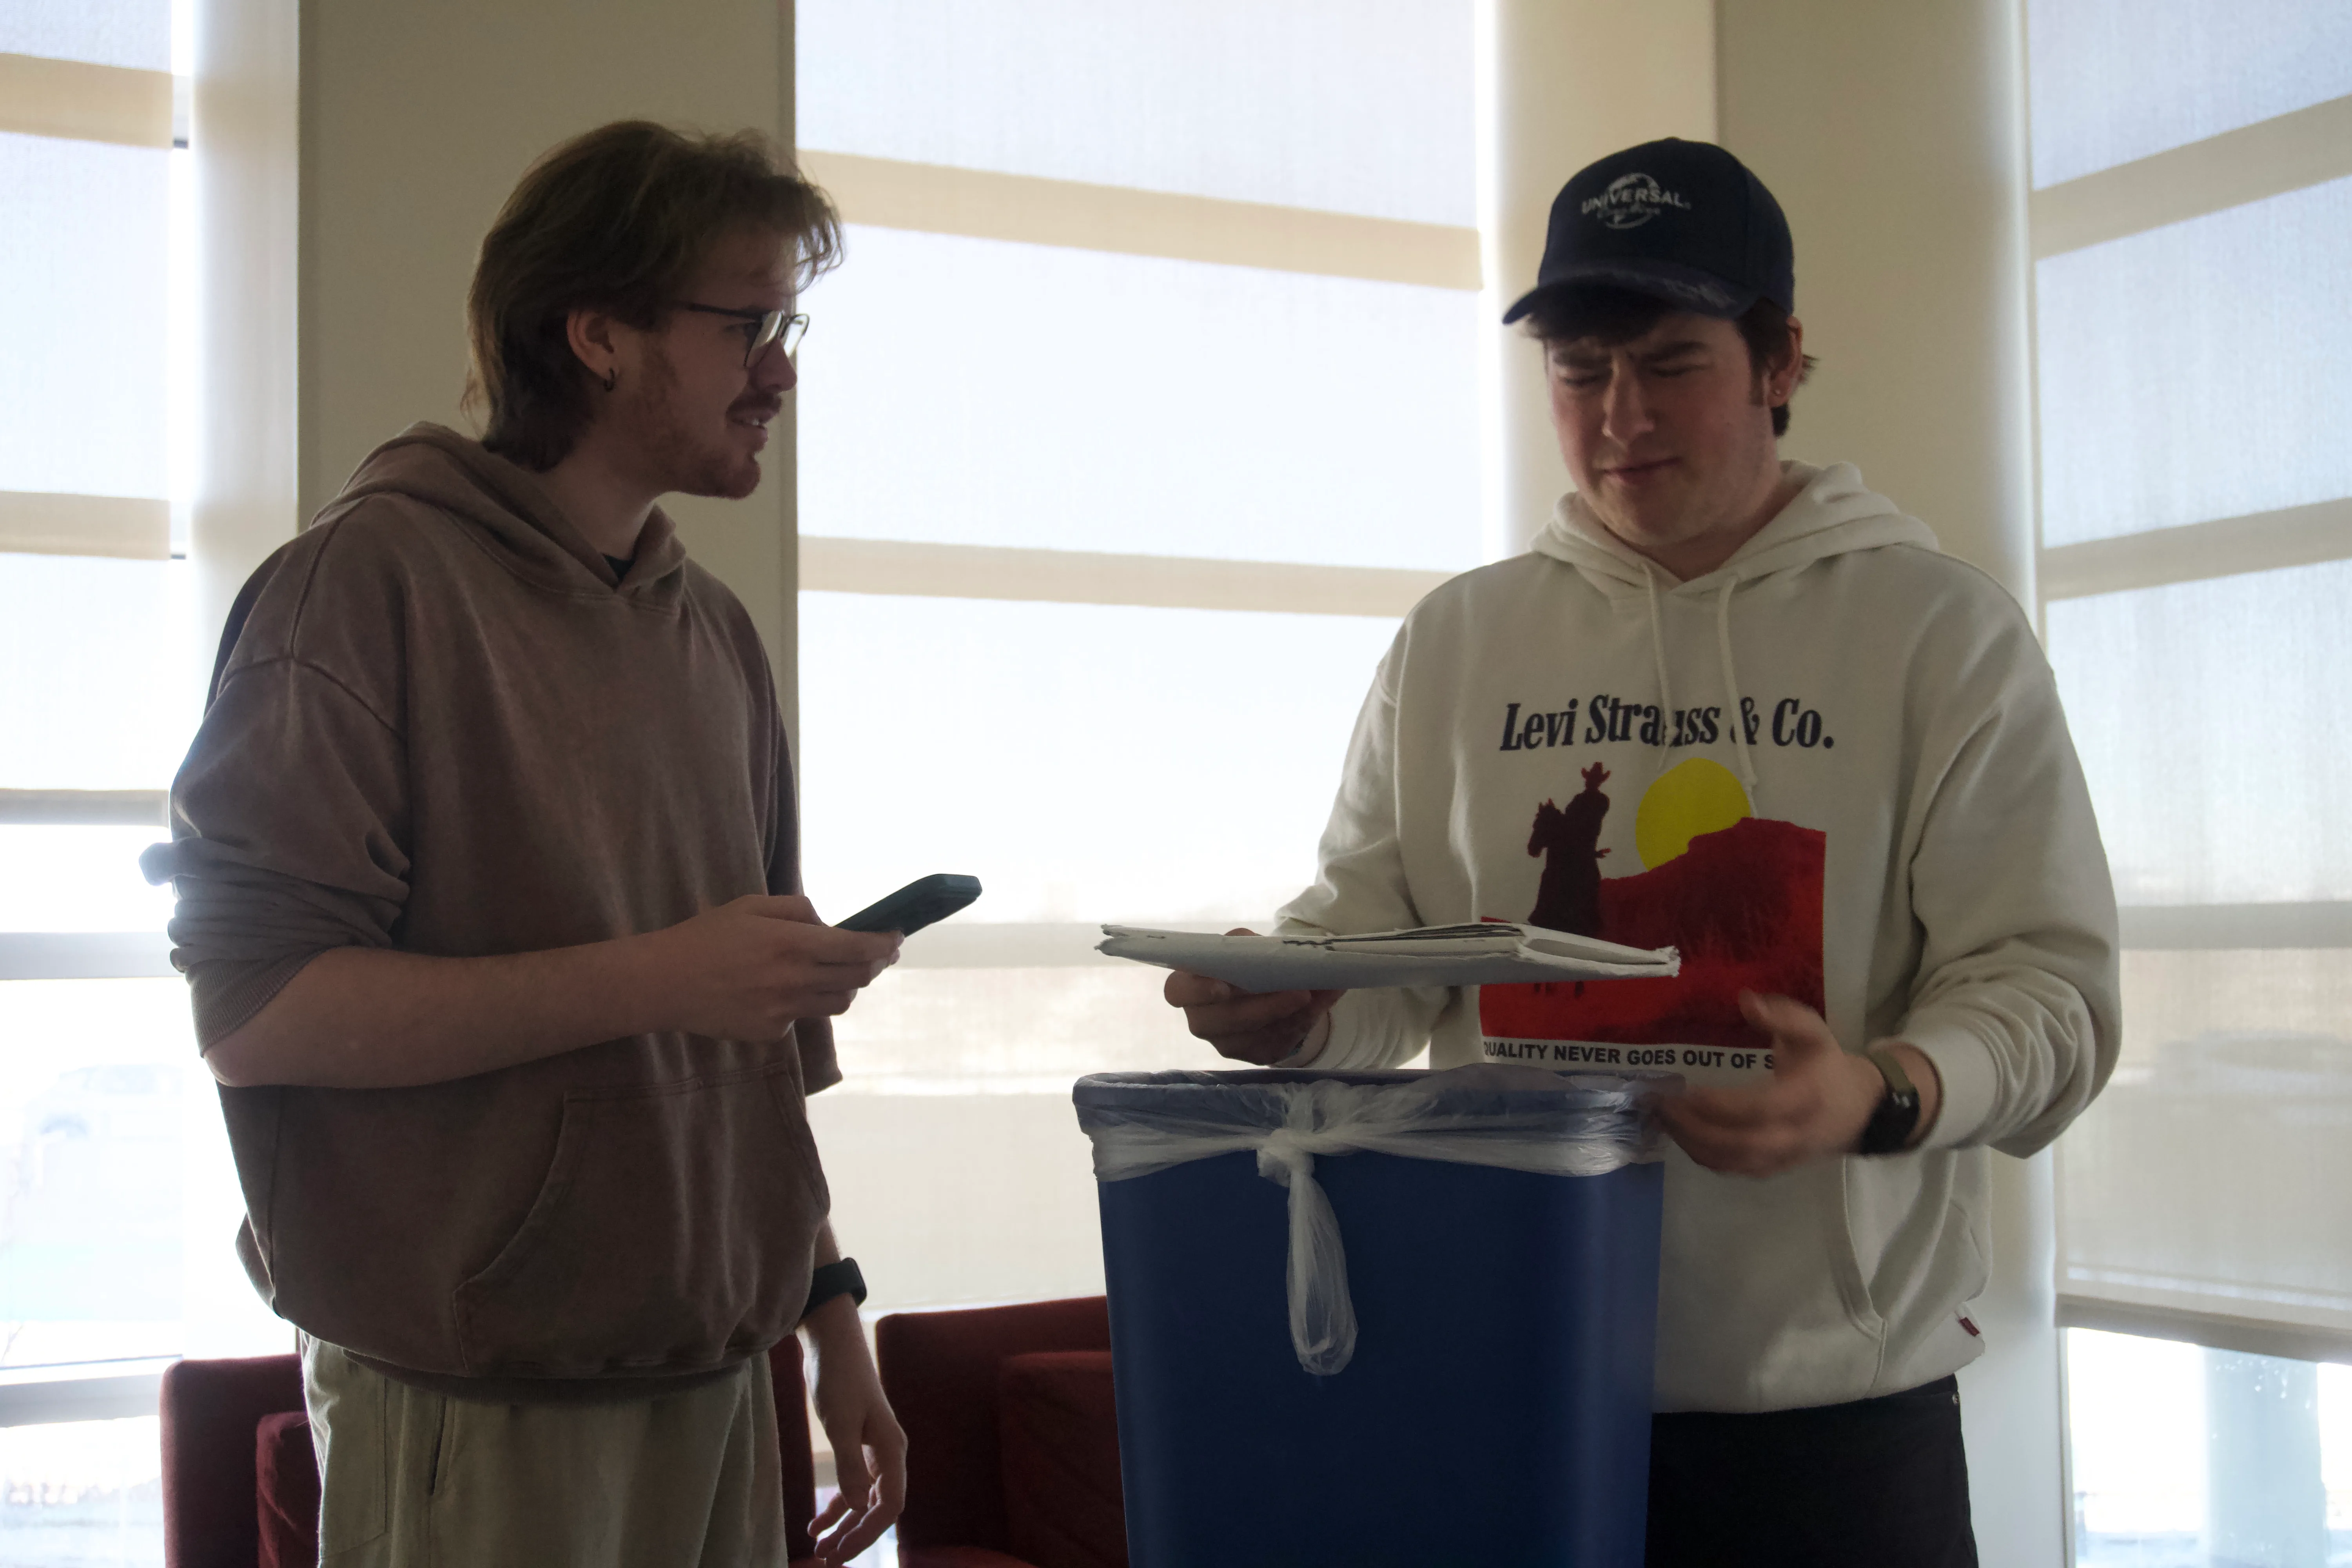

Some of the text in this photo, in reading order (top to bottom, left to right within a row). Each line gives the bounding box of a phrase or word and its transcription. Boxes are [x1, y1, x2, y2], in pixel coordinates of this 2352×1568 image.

[1581, 187, 1684, 214] UNIVERSAL
[1500, 698, 1579, 751] Levi
[1772, 698, 1835, 749] Co.
[1553, 1045, 1621, 1063] NEVER
[1627, 1049, 1676, 1066] GOES
[1682, 1050, 1724, 1068] OUT
[1730, 1053, 1757, 1069] OF
